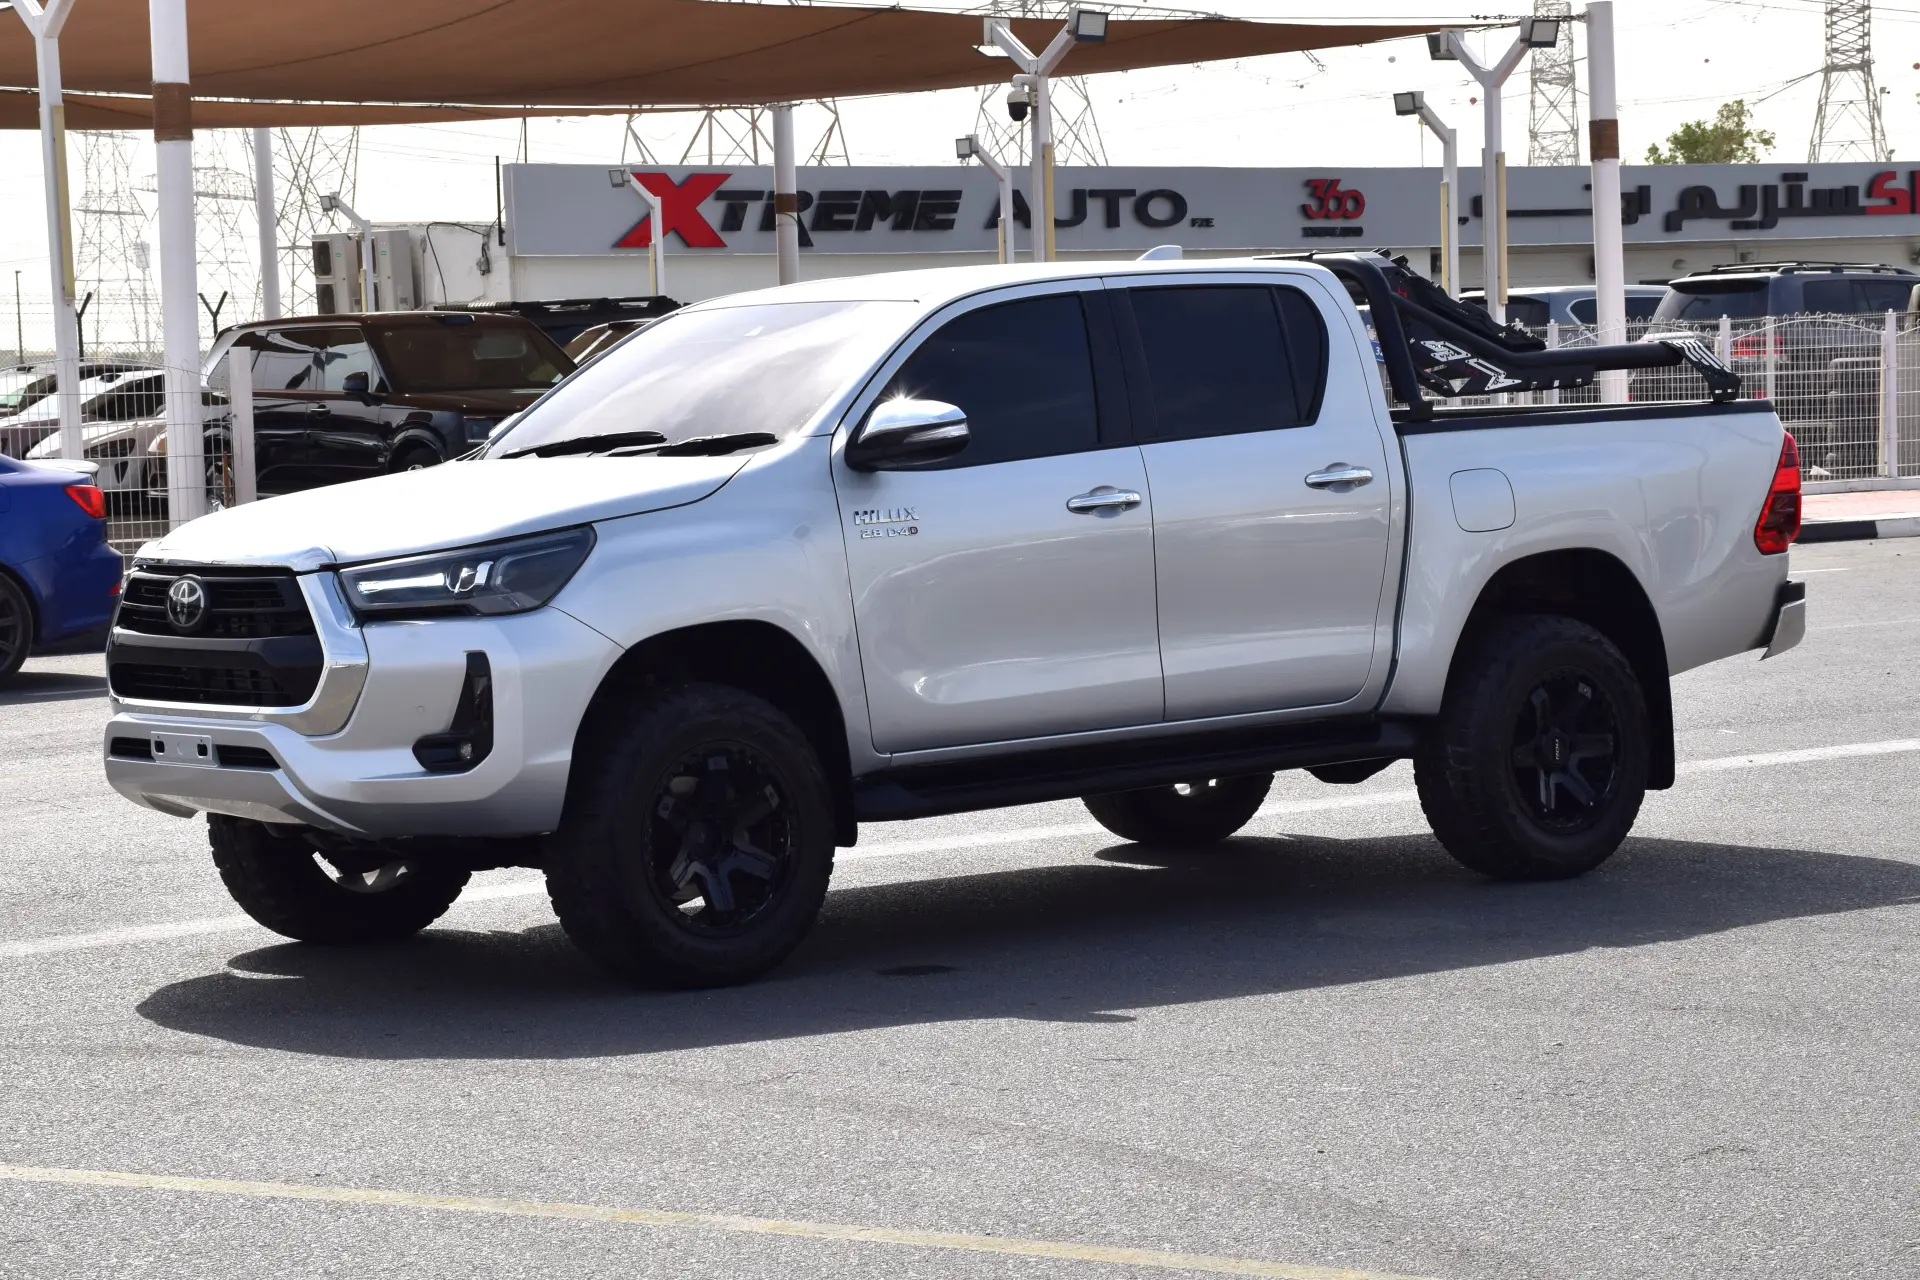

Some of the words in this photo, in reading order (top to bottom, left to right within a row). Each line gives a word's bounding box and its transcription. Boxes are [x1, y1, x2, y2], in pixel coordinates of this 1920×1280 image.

[613, 173, 963, 247] XTREME
[984, 188, 1188, 229] AUTO
[1301, 178, 1366, 220] 360
[854, 507, 920, 525] HILUX
